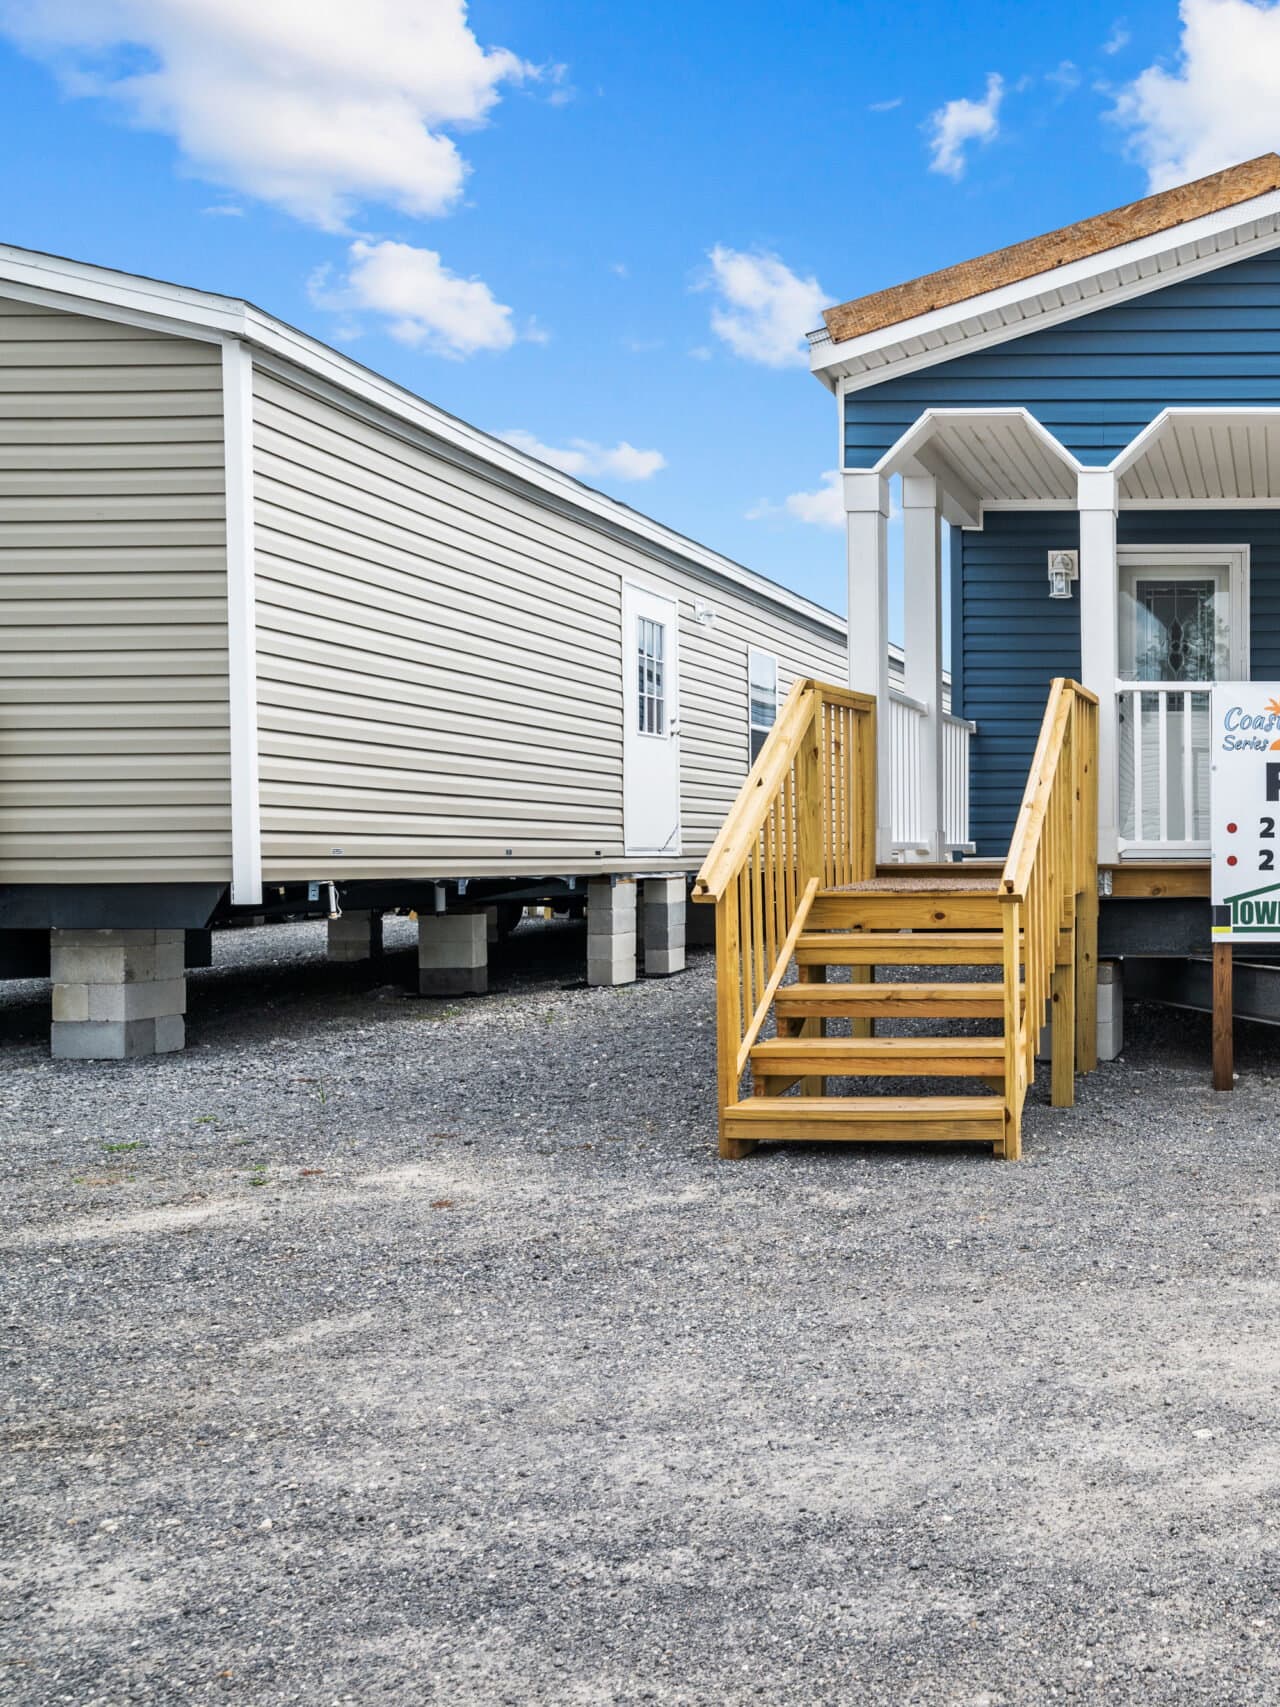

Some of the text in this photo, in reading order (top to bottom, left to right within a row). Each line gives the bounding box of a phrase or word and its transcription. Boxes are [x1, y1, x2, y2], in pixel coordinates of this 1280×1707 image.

[1221, 734, 1270, 752] Series
[1259, 816, 1276, 839] 2
[1258, 849, 1276, 871] 2
